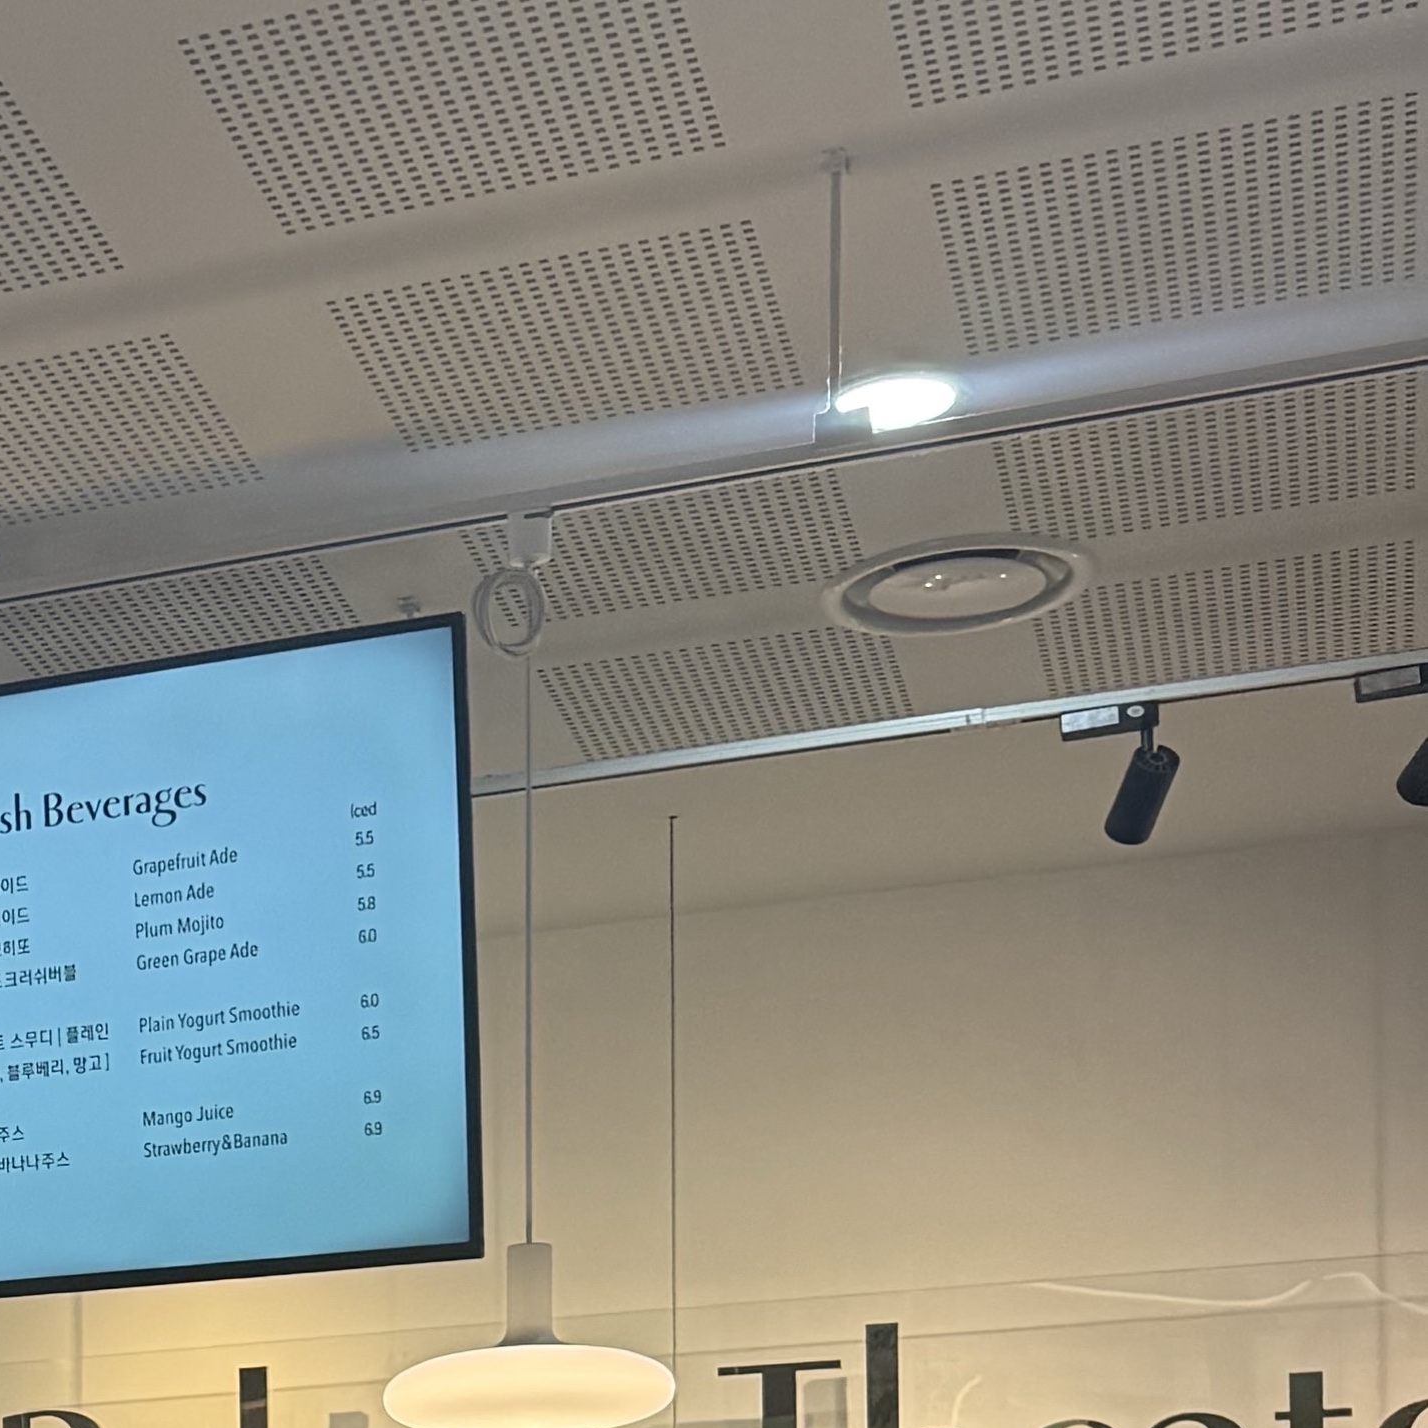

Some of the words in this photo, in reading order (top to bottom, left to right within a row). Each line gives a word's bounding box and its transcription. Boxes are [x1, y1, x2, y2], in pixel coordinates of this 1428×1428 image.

[44, 784, 206, 827] Beverages
[351, 802, 377, 818] Iced
[356, 830, 374, 846] 5.5
[133, 852, 206, 877] Grapefruit
[210, 847, 237, 865] Ade
[357, 863, 375, 879] 5.5
[135, 890, 182, 907] Lemon
[186, 882, 214, 901] Ade
[358, 896, 376, 911] 5.8
[136, 922, 172, 939] Plum
[178, 915, 224, 935] Mojito
[359, 928, 377, 944] 6.0
[137, 954, 178, 970] Green
[184, 948, 226, 966] Grape
[230, 941, 258, 959] Ade
[361, 993, 379, 1008] 6.0
[140, 1016, 174, 1033] Plain
[178, 1011, 225, 1031] Yogurt
[229, 1001, 300, 1023] Smoothie
[10, 1029, 53, 1050] 스무디
[67, 1023, 108, 1044] 플레인
[362, 1025, 380, 1040] 6.5
[141, 1047, 172, 1064] Fruit
[175, 1043, 223, 1063] Yogurt
[226, 1033, 297, 1055] Smoothie
[364, 1090, 381, 1104] 6.9
[143, 1111, 192, 1128] Mango
[196, 1104, 233, 1121] Juice
[364, 1121, 382, 1136] 6.9
[144, 1133, 287, 1158] Strawberry&Banana
